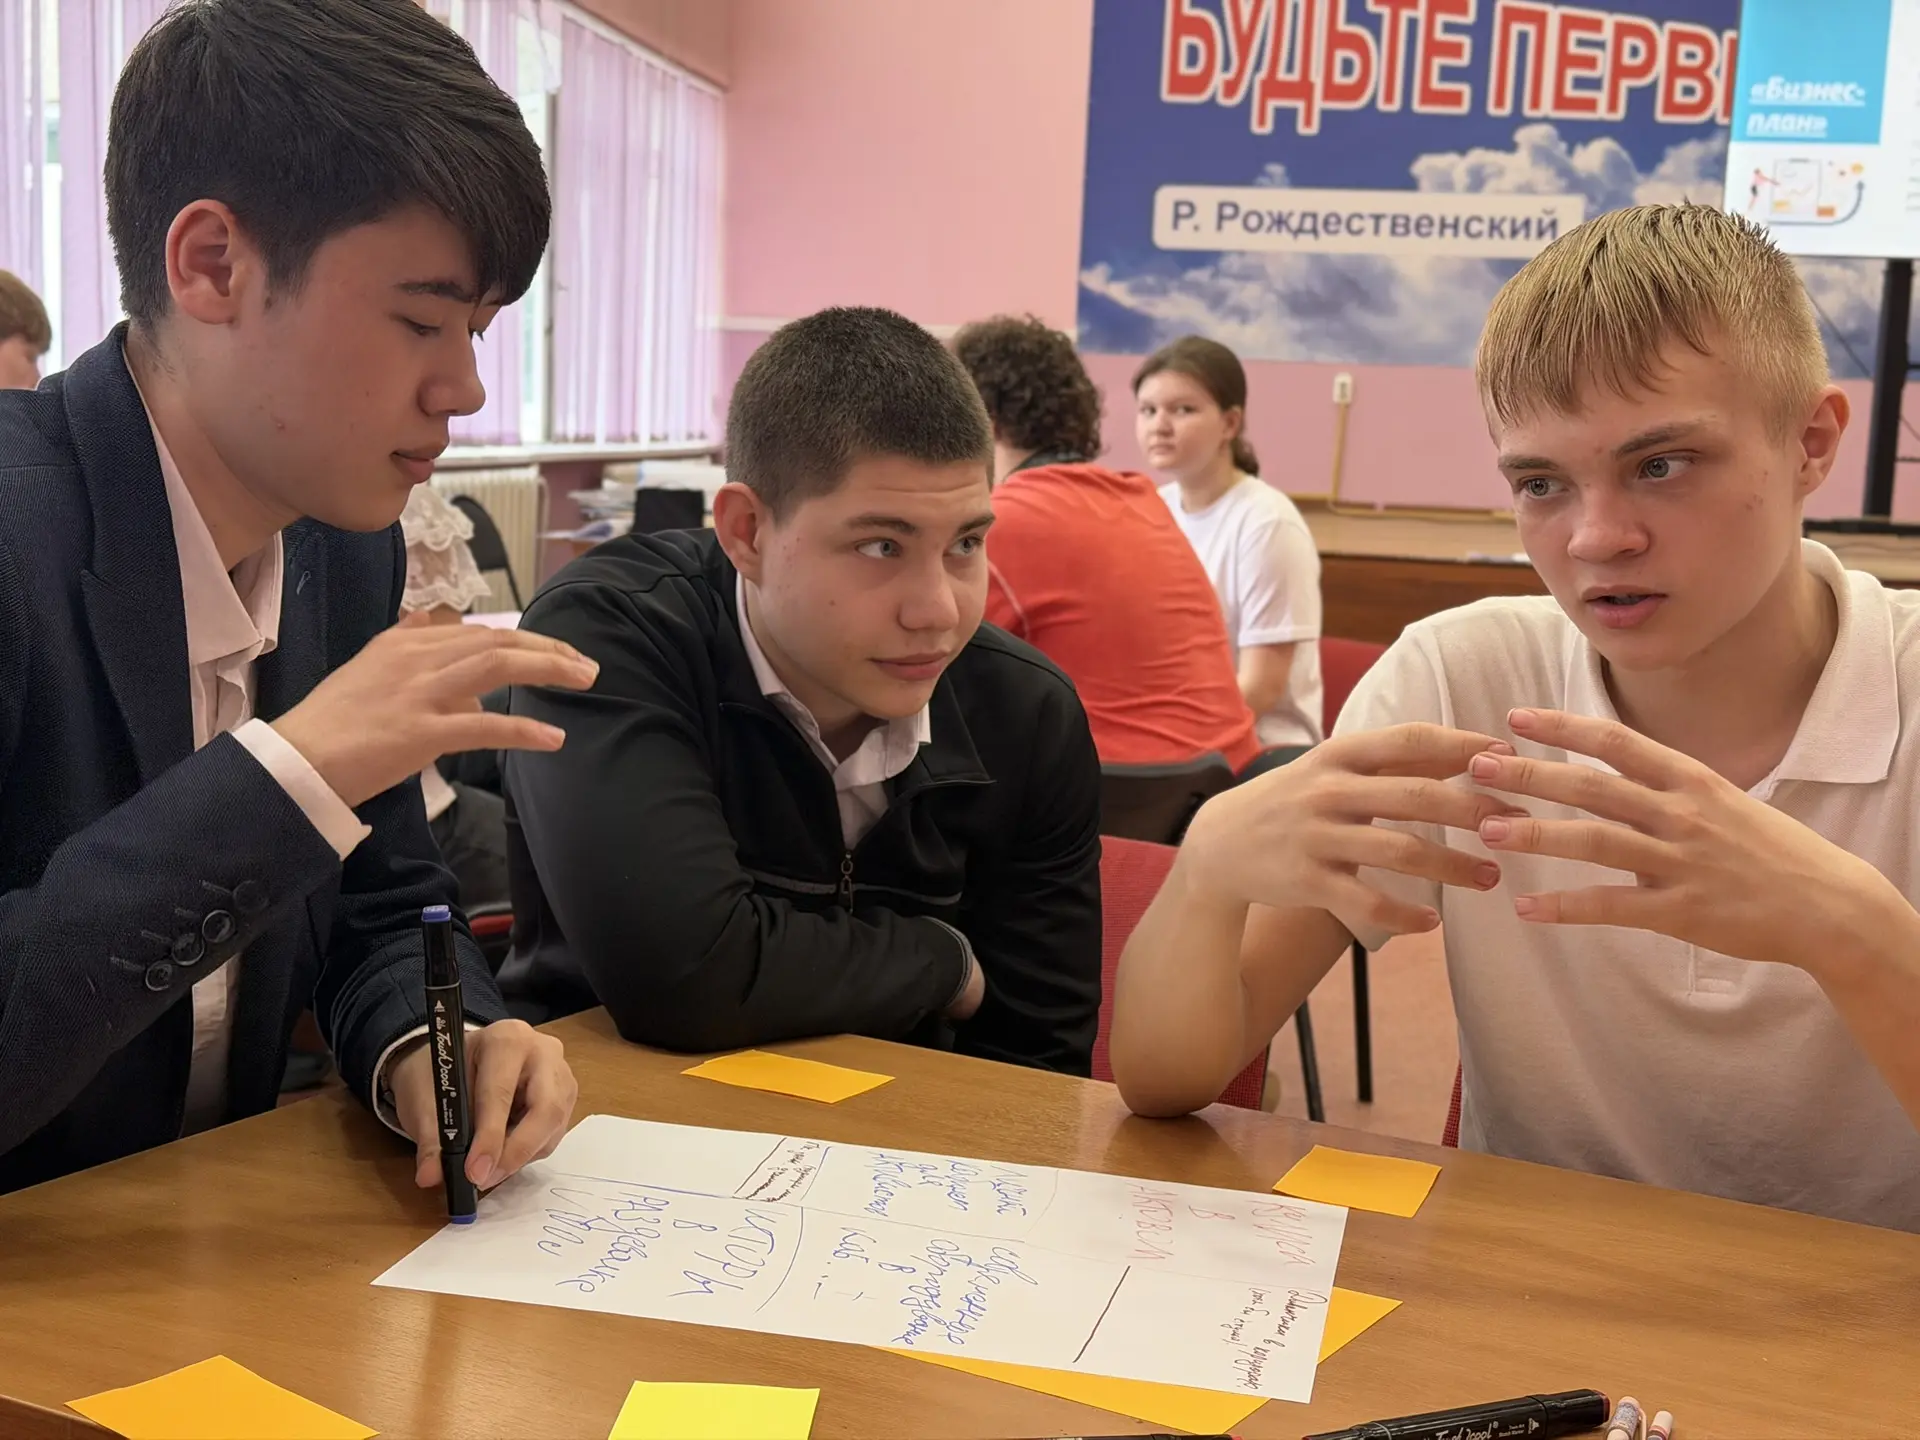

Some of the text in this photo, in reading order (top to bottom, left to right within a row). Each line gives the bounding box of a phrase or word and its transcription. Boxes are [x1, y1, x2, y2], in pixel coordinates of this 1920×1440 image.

[1160, 0, 1738, 135] БУДЬТЕ ПЕРВ
[1169, 202, 1559, 243] Р. Рождественский
